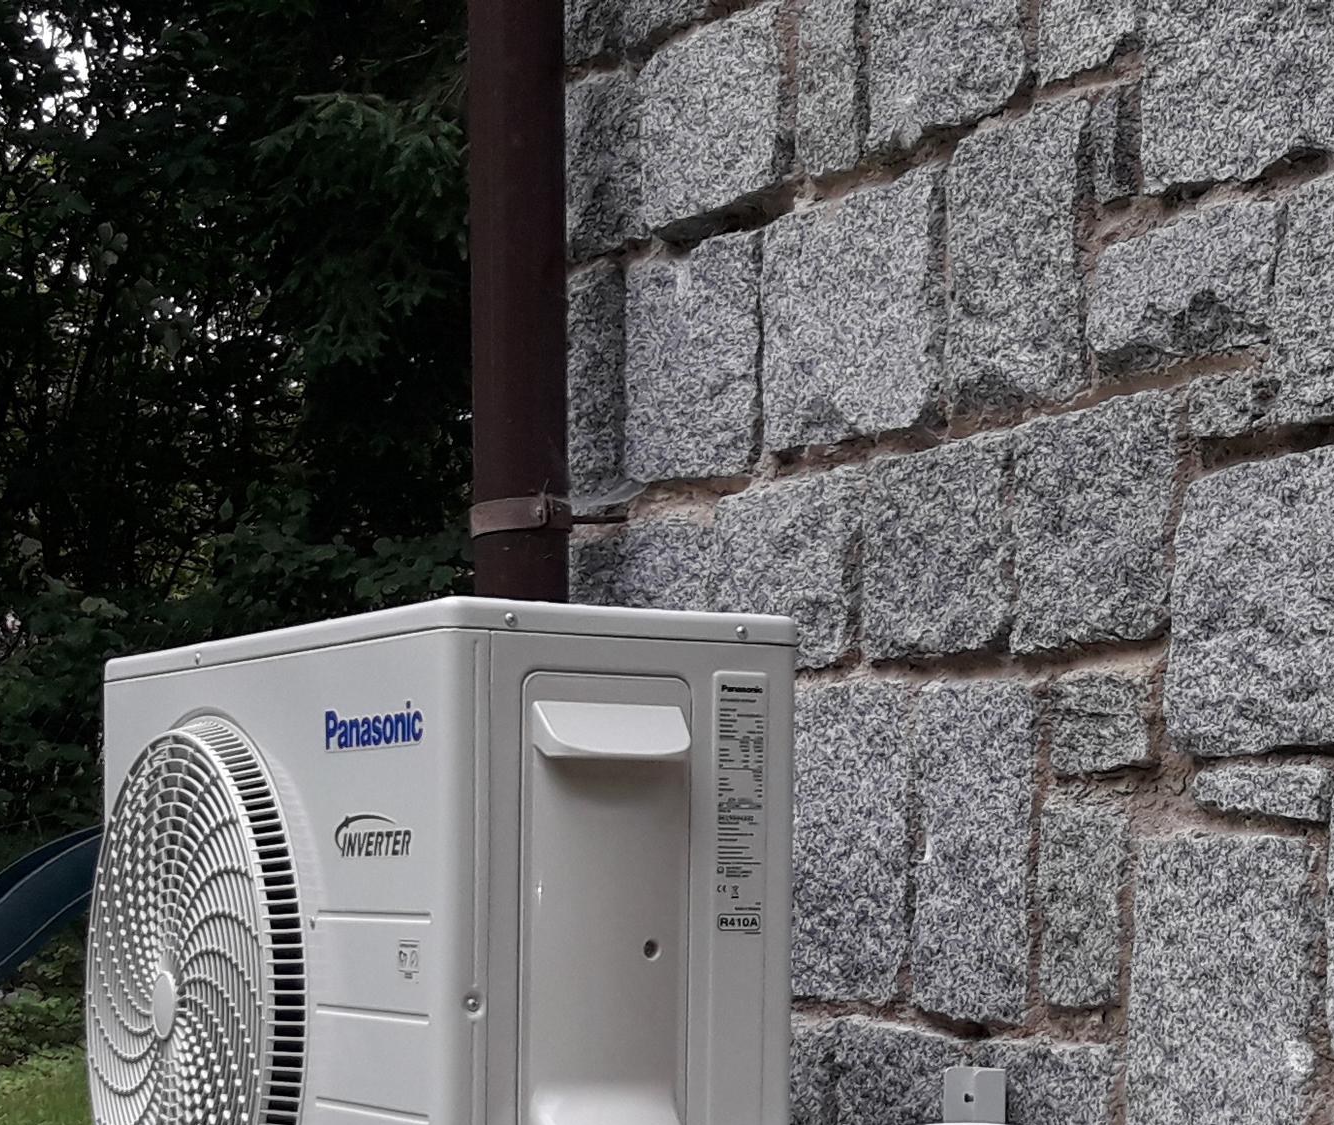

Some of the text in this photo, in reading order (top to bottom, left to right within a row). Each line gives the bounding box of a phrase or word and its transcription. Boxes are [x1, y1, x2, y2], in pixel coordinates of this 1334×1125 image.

[721, 684, 763, 694] Panasonic
[325, 700, 423, 750] Panasonic
[341, 829, 412, 857] INVERTER
[720, 917, 758, 927] R410A
